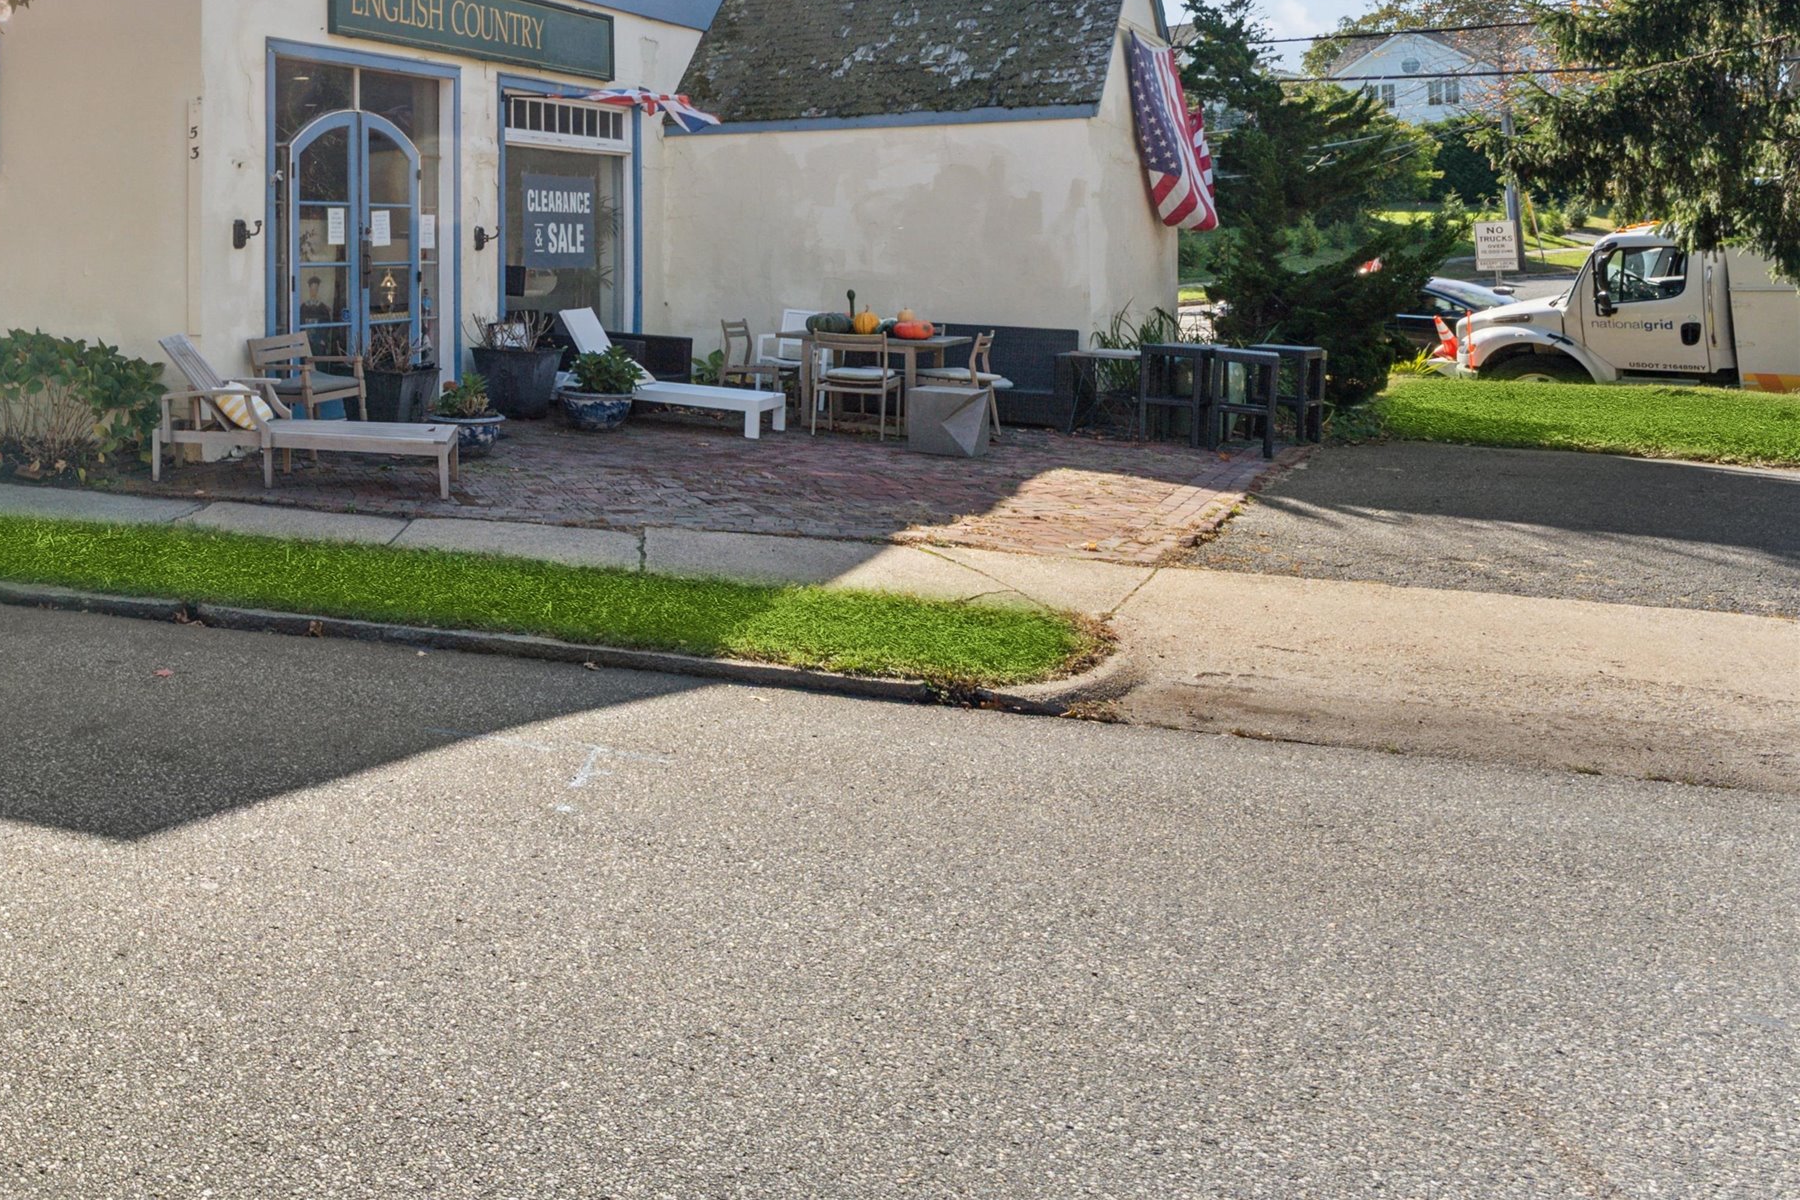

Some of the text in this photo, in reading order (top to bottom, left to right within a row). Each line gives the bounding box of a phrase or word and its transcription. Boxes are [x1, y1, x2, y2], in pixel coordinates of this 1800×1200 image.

[451, 0, 545, 50] COUNTRY
[526, 188, 591, 214] CLEARANCE
[534, 222, 585, 254] & SALE
[1486, 226, 1504, 235] NO
[1591, 318, 1674, 332] nationalgrid
[1628, 361, 1660, 369] USDOT
